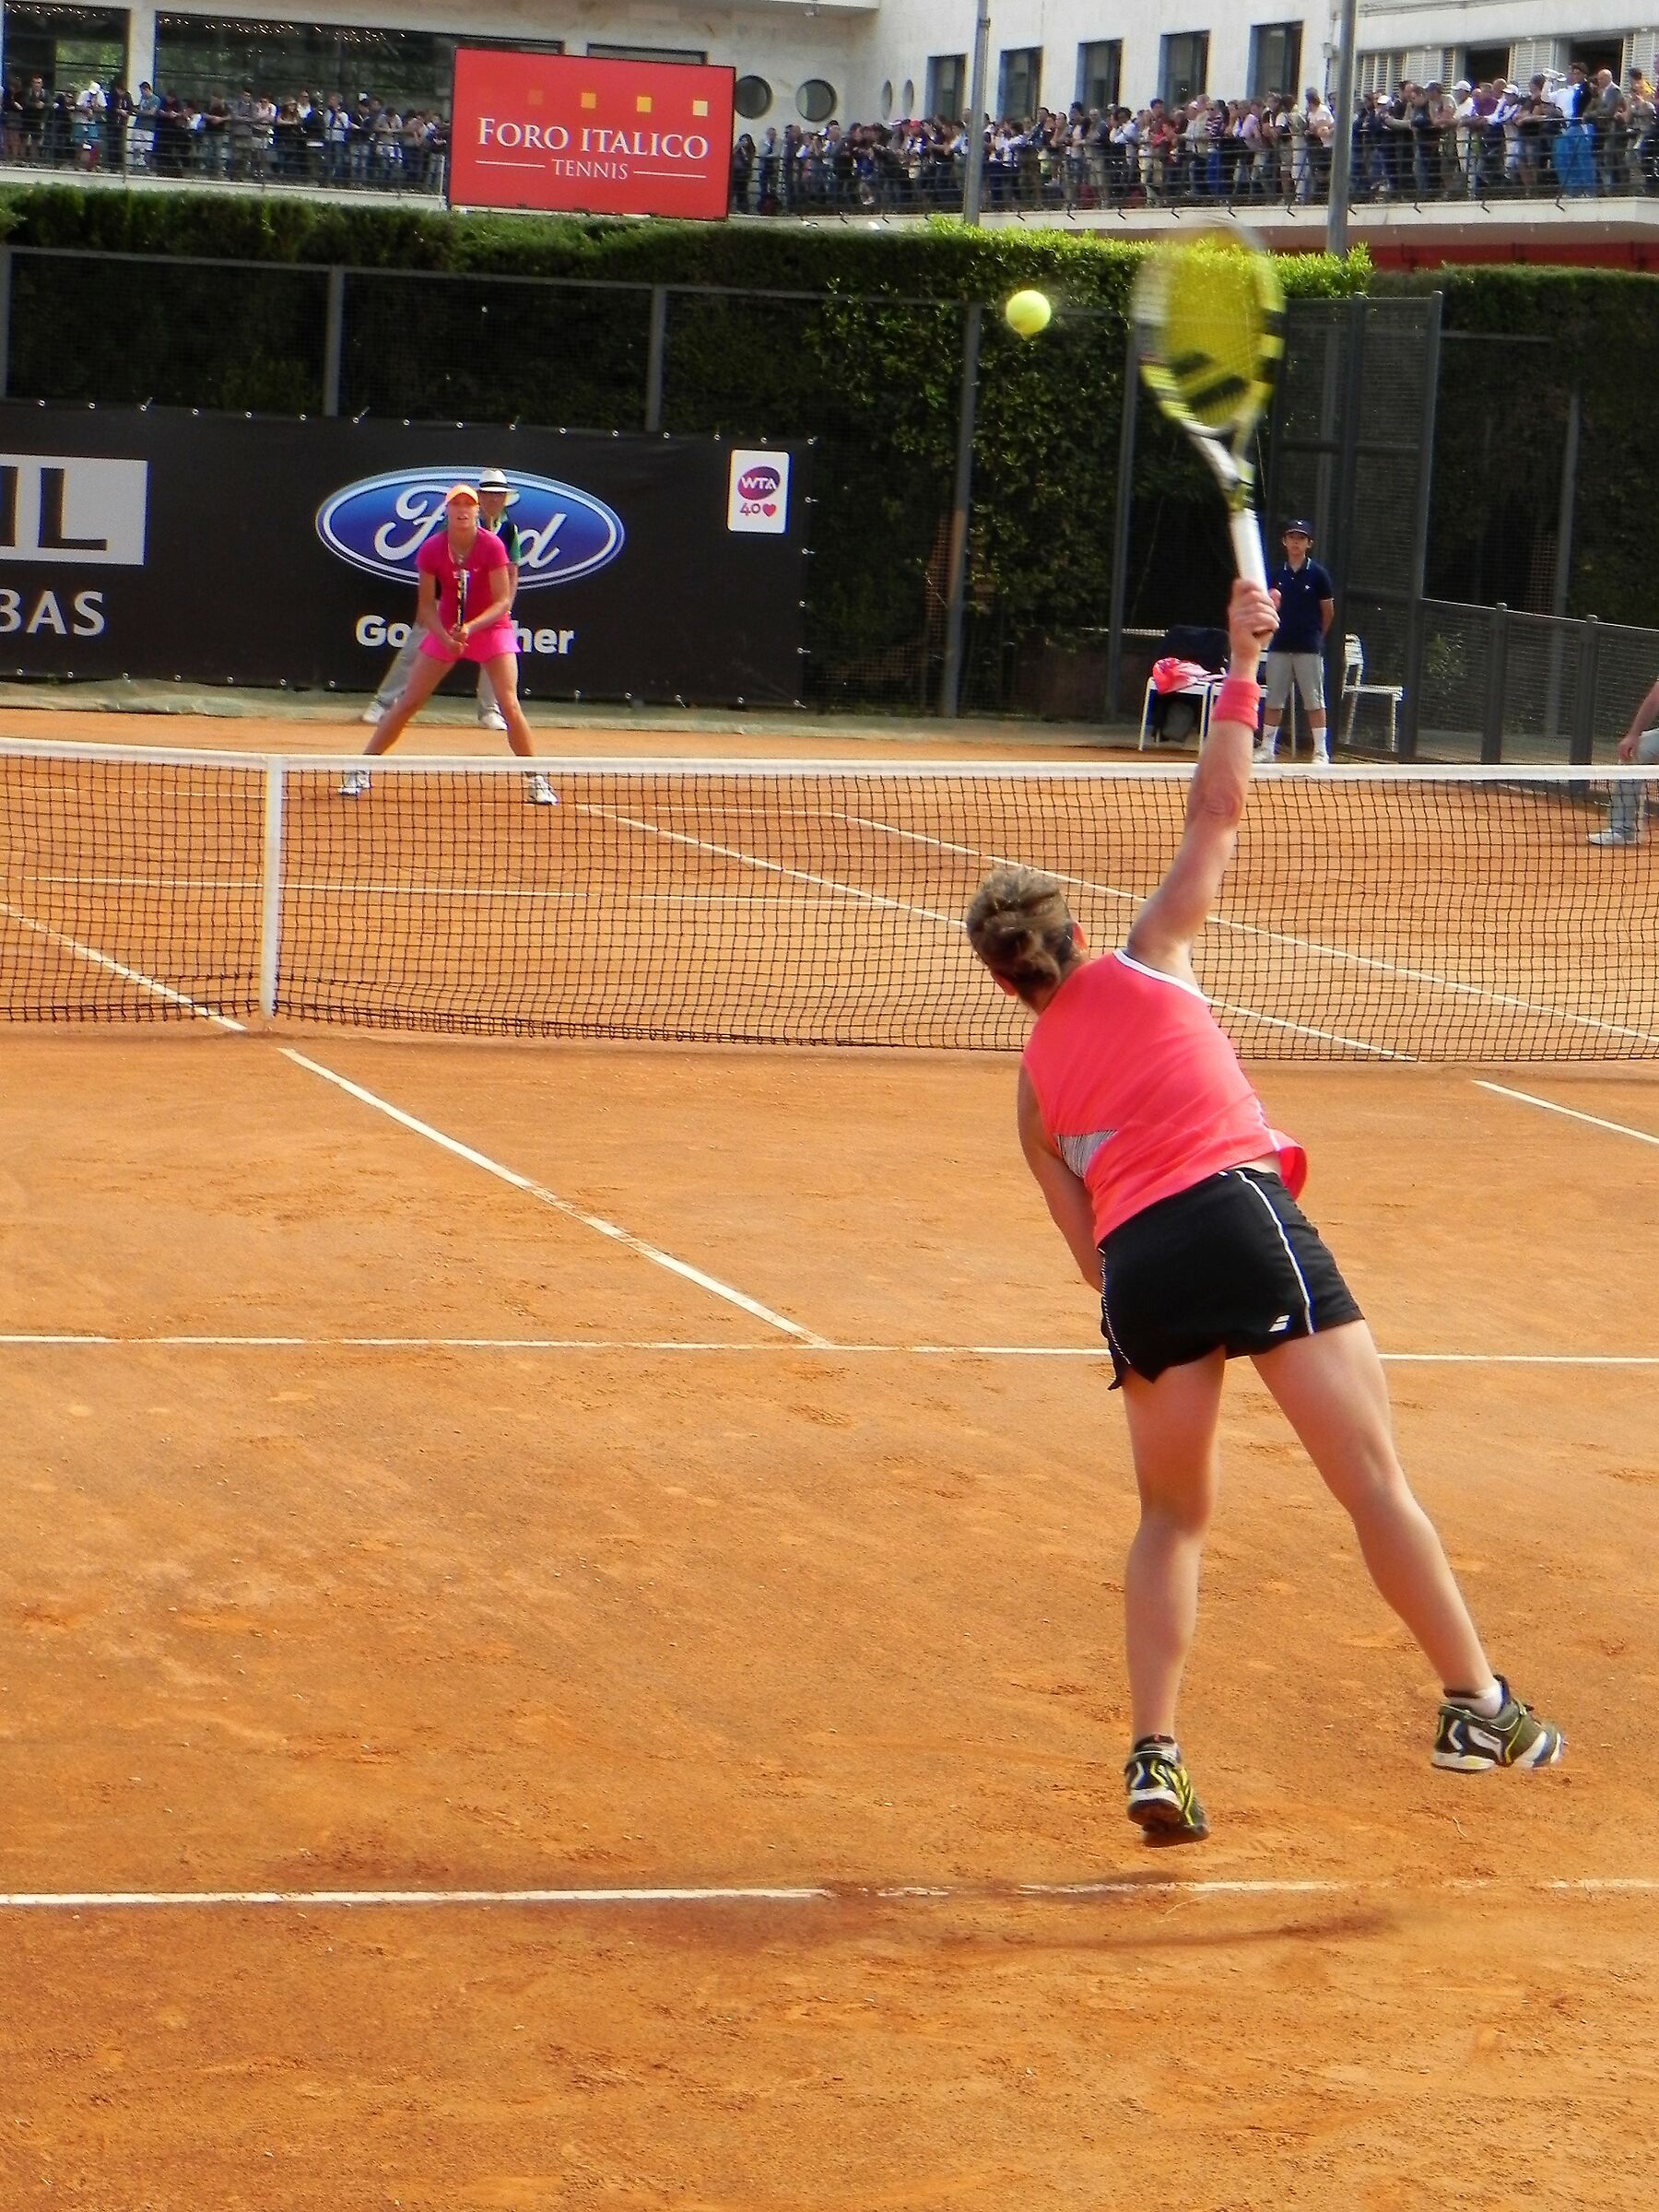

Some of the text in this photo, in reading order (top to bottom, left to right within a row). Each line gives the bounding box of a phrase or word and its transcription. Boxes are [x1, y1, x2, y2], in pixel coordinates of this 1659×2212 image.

[552, 159, 629, 180] TENNIS
[741, 477, 777, 489] WTA
[740, 502, 761, 516] 40
[356, 615, 413, 648] Go
